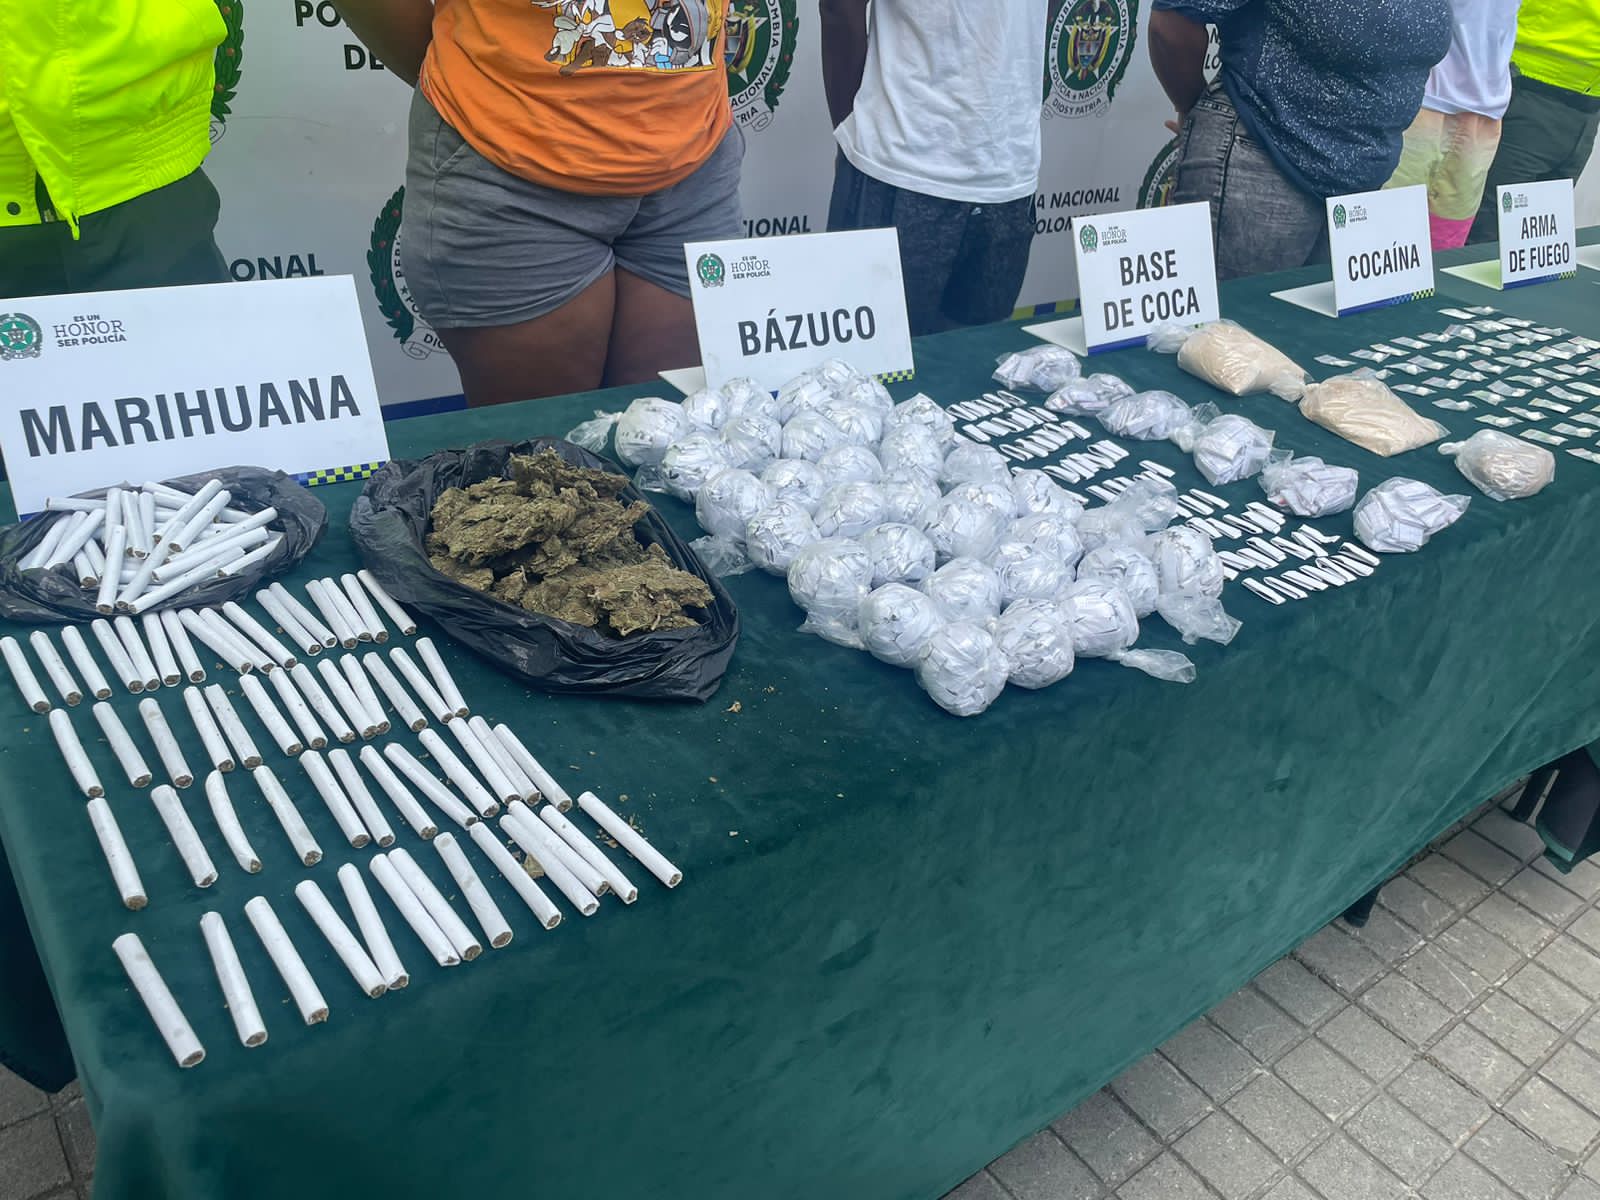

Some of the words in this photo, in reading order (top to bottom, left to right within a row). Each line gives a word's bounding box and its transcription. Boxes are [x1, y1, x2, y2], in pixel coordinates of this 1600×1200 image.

[736, 106, 758, 122] RIA
[1050, 187, 1120, 208] NACIONAL
[743, 215, 811, 238] IONAL
[1521, 214, 1557, 239] ARMA
[731, 260, 770, 273] HONOR
[1120, 250, 1178, 286] BASE
[1348, 241, 1420, 281] COCAÍNA
[1509, 249, 1526, 272] DE
[1530, 242, 1570, 269] FUEGO
[1104, 298, 1134, 331] DE
[1141, 286, 1200, 324] COCA
[53, 320, 125, 338] HONOR
[58, 339, 79, 347] SER
[82, 334, 127, 345] POLICÍA
[738, 305, 876, 356] BÁZUCO
[20, 374, 361, 457] MARIHUANA
